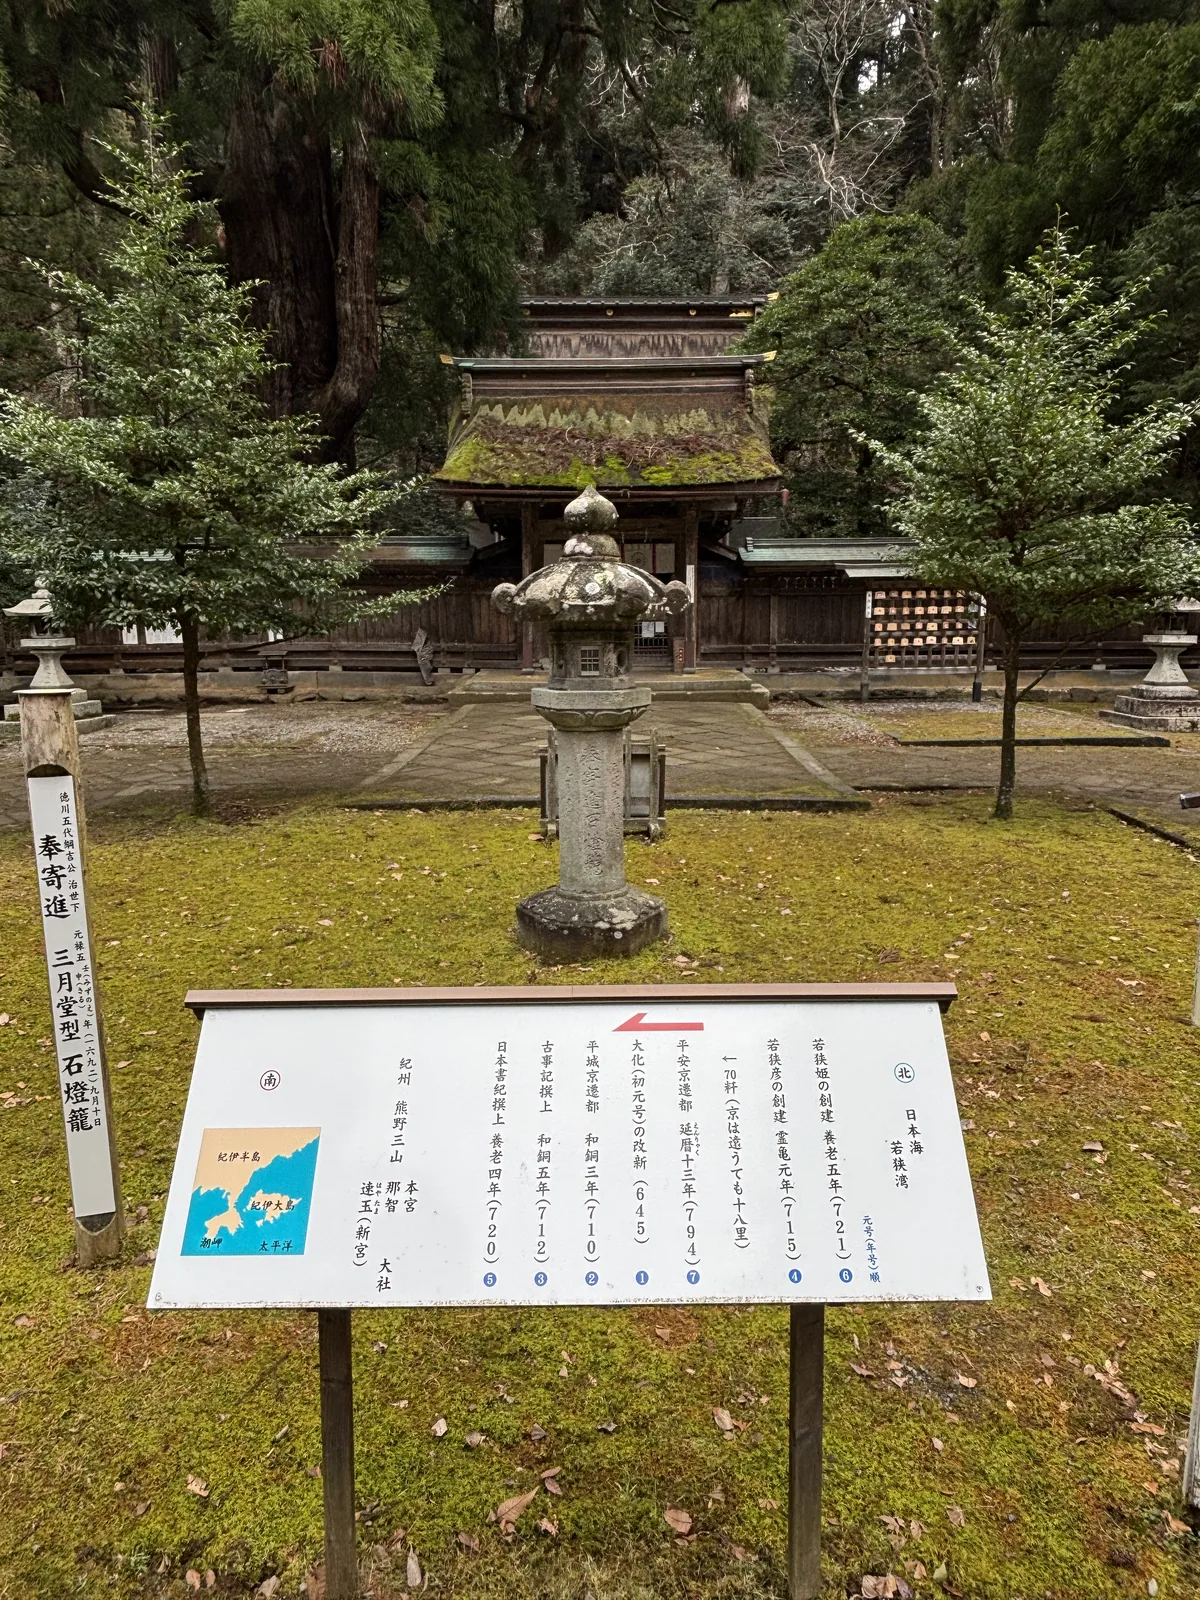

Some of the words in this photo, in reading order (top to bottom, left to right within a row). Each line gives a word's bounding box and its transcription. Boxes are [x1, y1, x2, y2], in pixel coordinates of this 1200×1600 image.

[38, 834, 71, 919] 奉寄進
[59, 792, 77, 874] 徳川五代綱吉公
[68, 879, 80, 913] 治世下
[74, 929, 86, 963] 元禄五
[52, 948, 82, 1042] 三月堂型
[62, 1053, 93, 1133] 石燈籠
[262, 1072, 278, 1088] 南
[397, 1057, 413, 1086] 紀州
[491, 1041, 508, 1126] 日本書紀撰上
[539, 1040, 554, 1113] 古事記撰上
[585, 1040, 600, 1114] 平城京遷都
[631, 1038, 648, 1171] 大化(初元号)の改新
[677, 1039, 693, 1113] 平安京遷都
[767, 1038, 789, 1123] 若狭彦の創建
[811, 1037, 836, 1123] 若狭姫の創建
[896, 1065, 913, 1081] 北
[217, 1151, 261, 1162] 紀伊半島
[389, 1100, 409, 1163] 熊野三山
[890, 1140, 909, 1189] 若狭湾
[905, 1108, 925, 1155] 日本海
[250, 1200, 295, 1211] 紀伊大島
[352, 1181, 375, 1267] 速玉(新宮)
[384, 1181, 401, 1213] 那智
[403, 1180, 419, 1213] 本宮
[483, 1133, 504, 1264] 養老四年(720)
[533, 1133, 552, 1264] 和銅五年(712)
[583, 1132, 601, 1263] 和銅三年(710)
[632, 1180, 650, 1244] (645)
[679, 1121, 701, 1266] 延暦十三年(794)
[775, 1130, 802, 1261] 霊亀元年(715)
[822, 1129, 852, 1260] 養老五年(721)
[200, 1237, 223, 1249] 潮岬
[258, 1239, 293, 1253] 太平洋
[375, 1257, 393, 1293] 大社
[862, 1214, 881, 1283] 元号(年号)順
